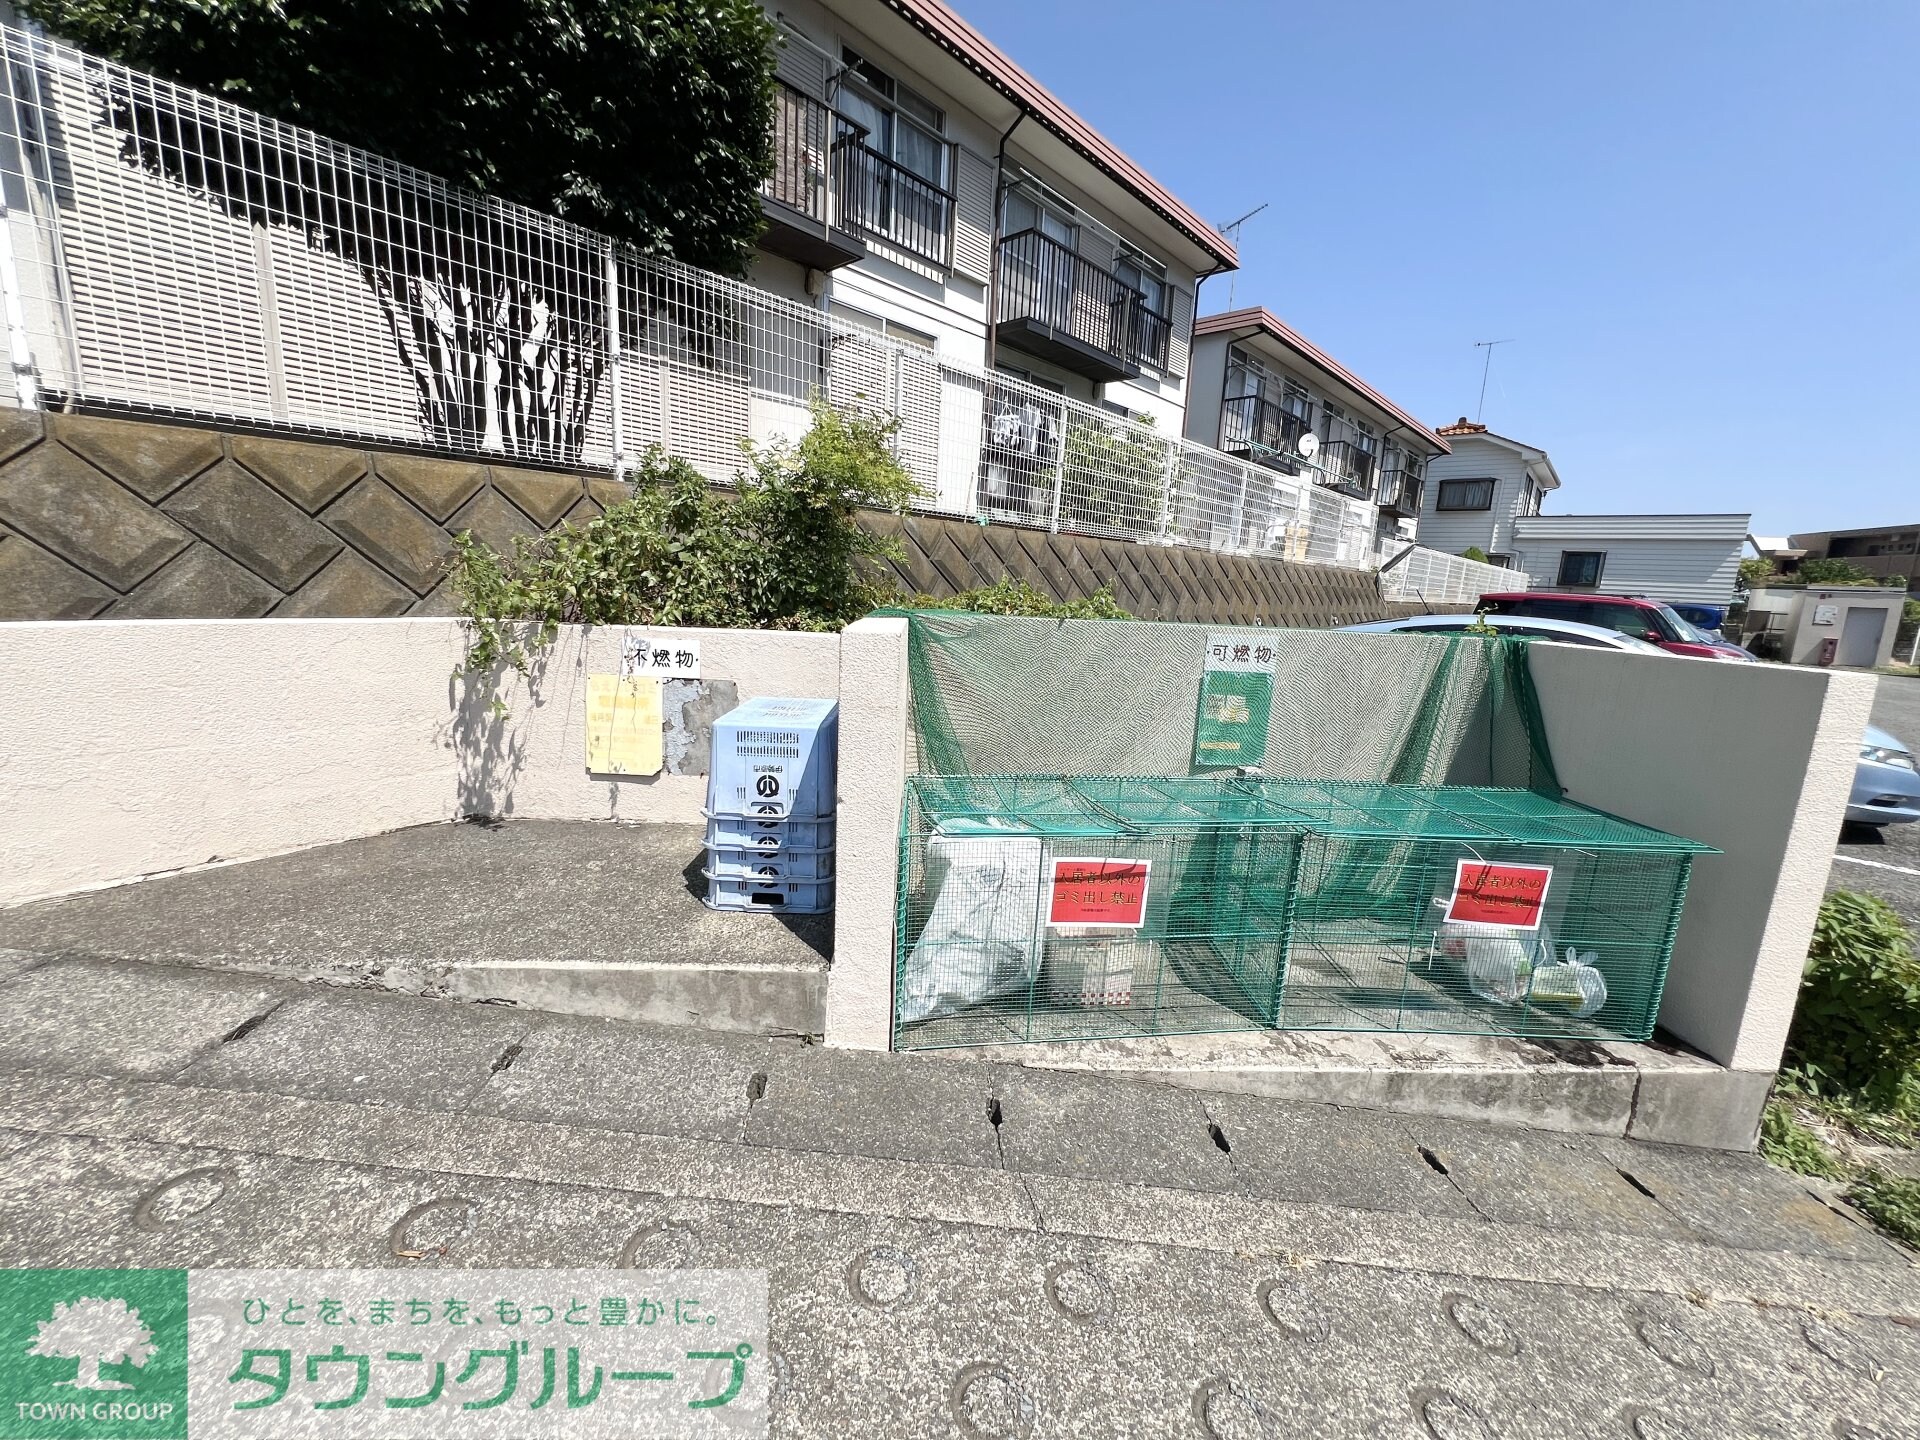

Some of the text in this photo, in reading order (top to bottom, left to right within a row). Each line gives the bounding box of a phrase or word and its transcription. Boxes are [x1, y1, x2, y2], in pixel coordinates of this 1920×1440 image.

[634, 648, 694, 668] 不燃物
[1213, 644, 1272, 663] 可燃物
[1056, 890, 1138, 905] ゴミ出し禁止
